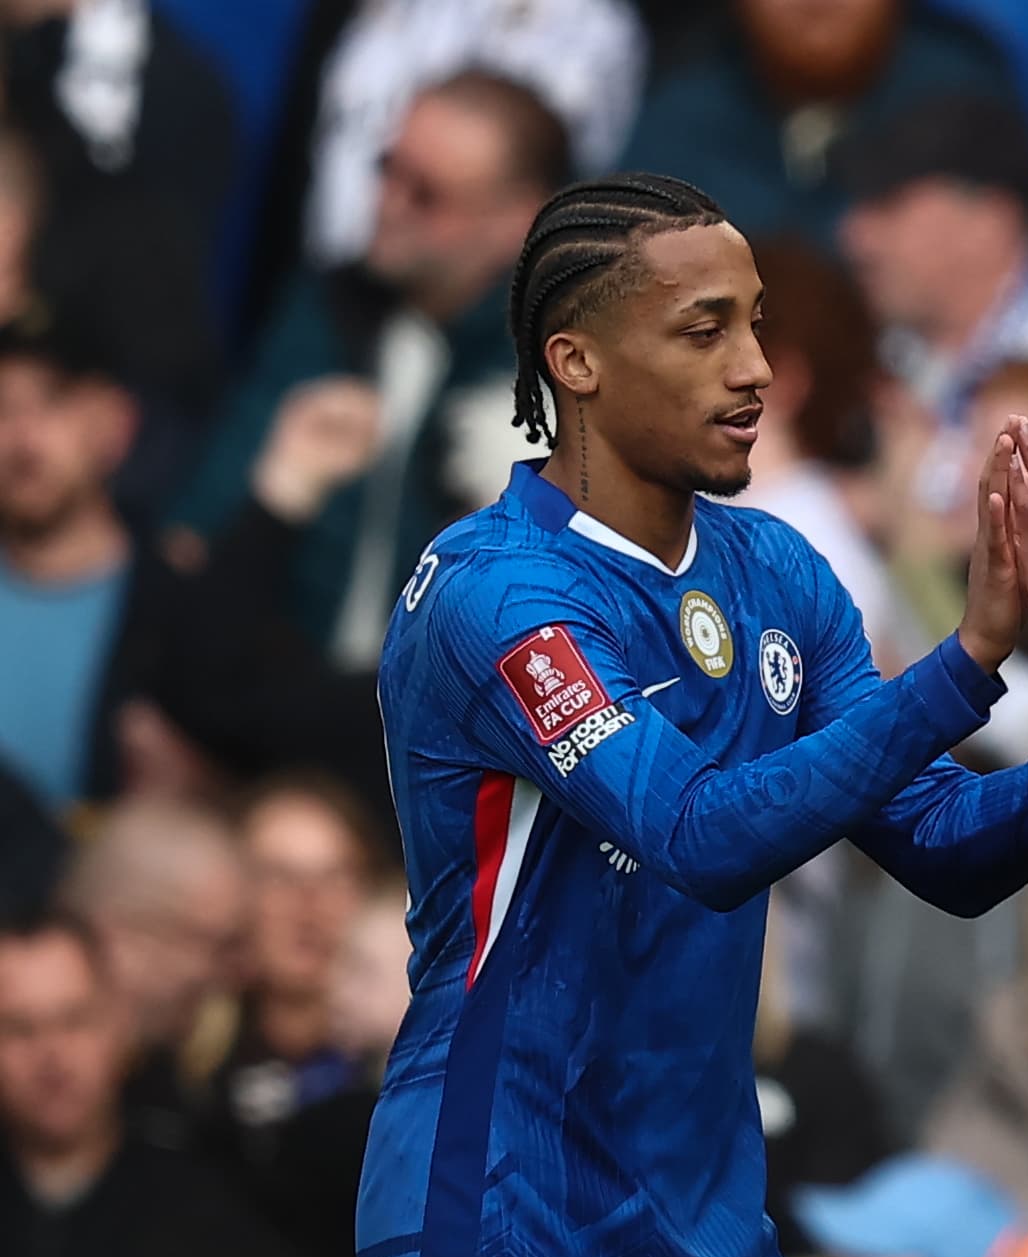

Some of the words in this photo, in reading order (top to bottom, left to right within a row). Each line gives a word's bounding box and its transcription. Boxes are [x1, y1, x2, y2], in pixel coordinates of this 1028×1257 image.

[704, 655, 726, 672] FIFA
[535, 679, 586, 719] Emirates
[542, 712, 564, 731] FA
[560, 689, 593, 716] CUP
[548, 740, 571, 763] No
[569, 704, 619, 744] room
[554, 749, 579, 778] for
[576, 712, 636, 755] racism
